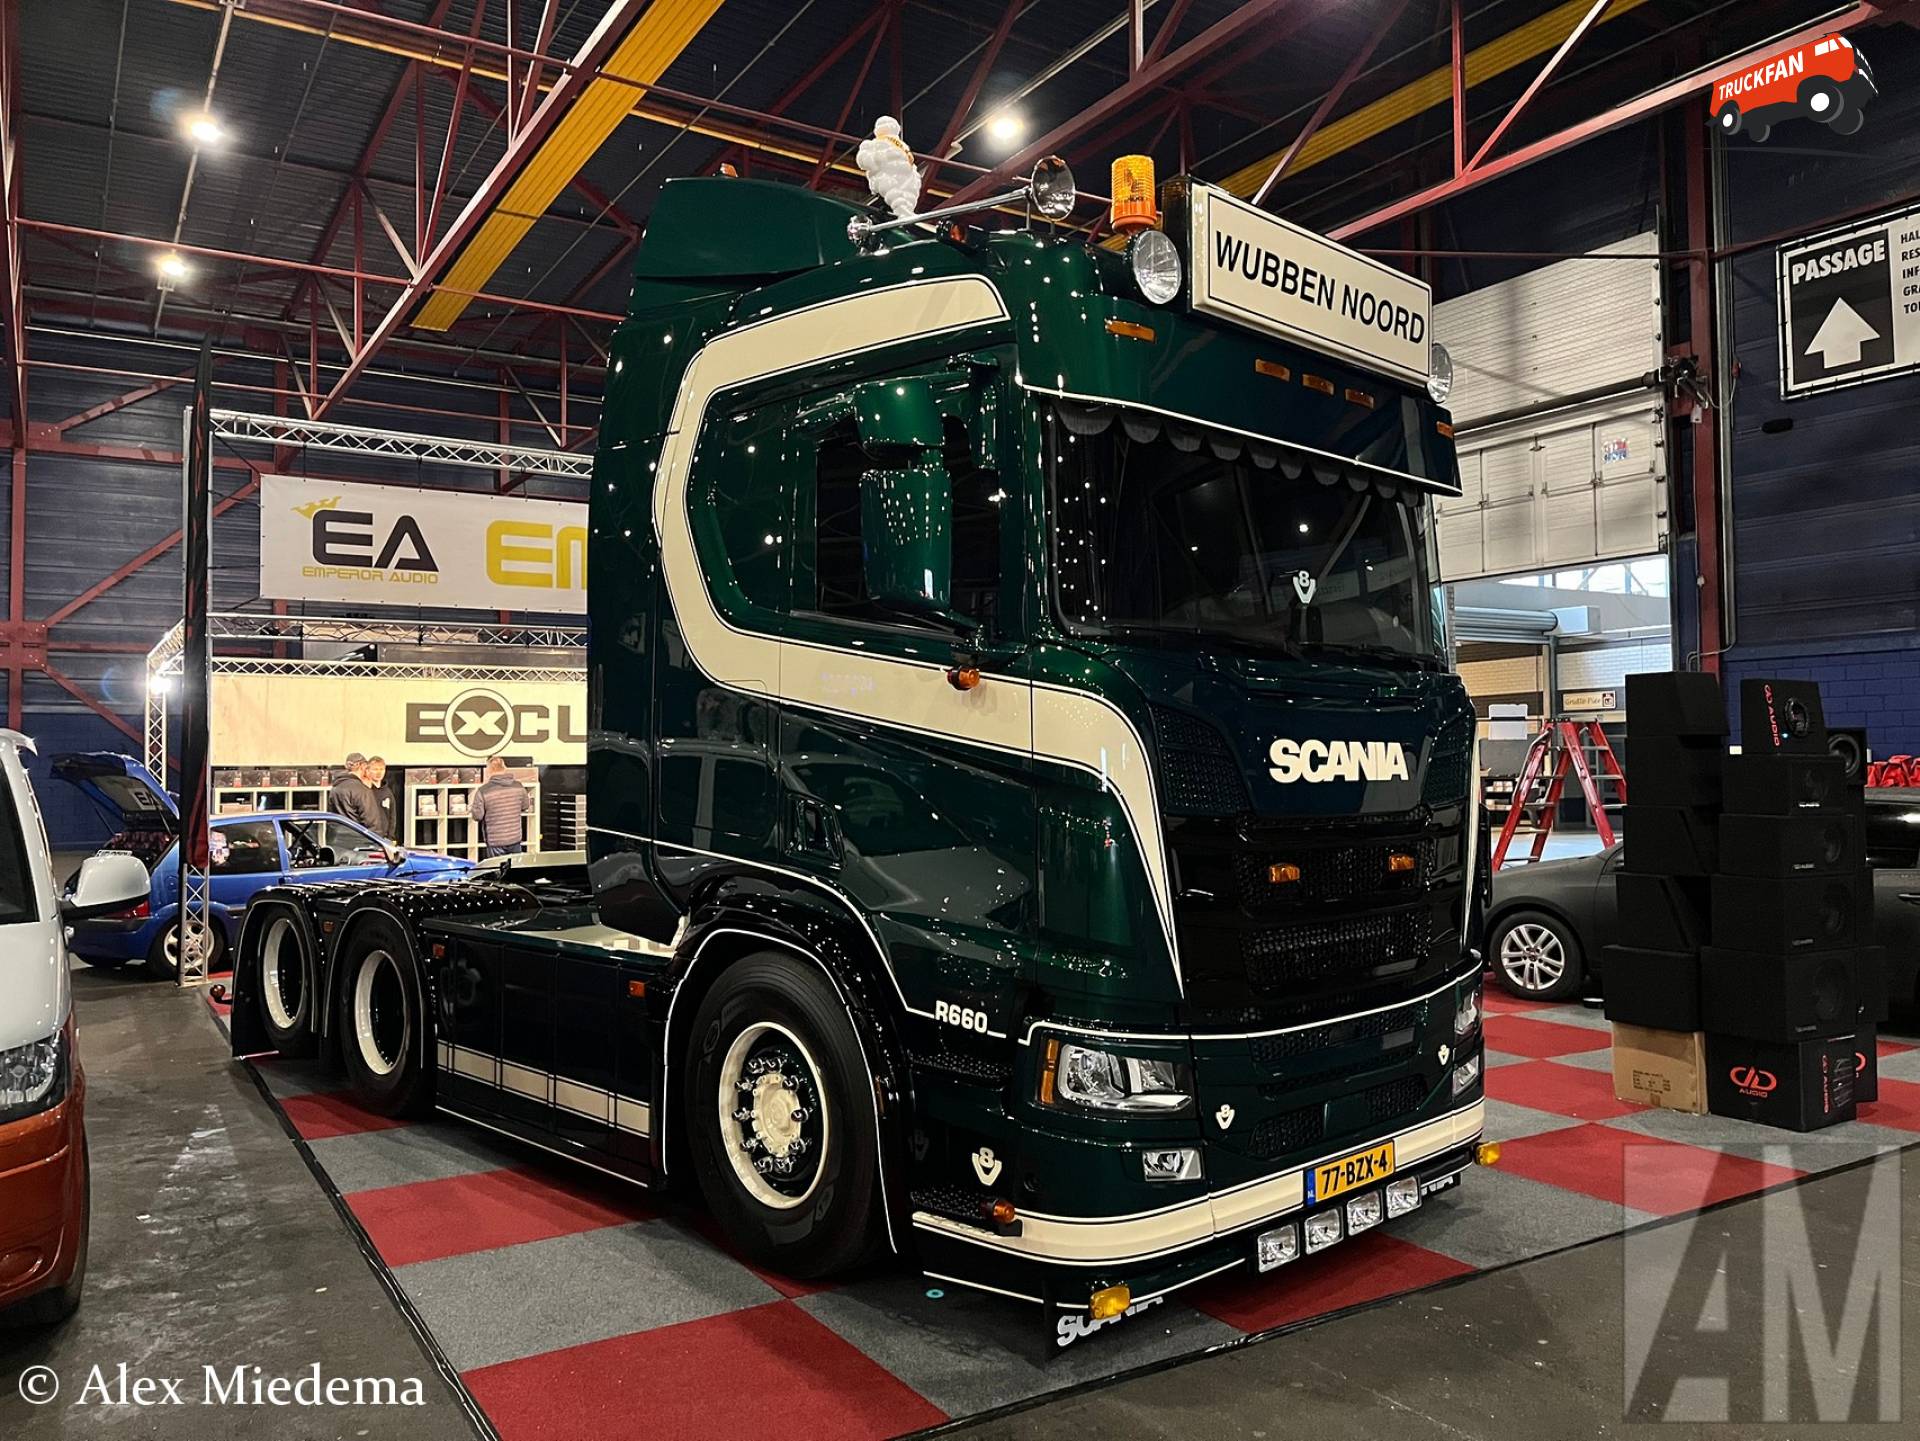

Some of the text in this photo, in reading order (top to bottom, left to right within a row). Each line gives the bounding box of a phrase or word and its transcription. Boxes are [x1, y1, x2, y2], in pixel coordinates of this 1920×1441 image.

[1792, 239, 1886, 284] PASSAGE
[1216, 231, 1425, 344] WUBBEN NOORD
[1903, 285, 1920, 296] GR
[1904, 301, 1920, 314] TO
[312, 509, 439, 572] EA
[302, 566, 439, 585] EMPEROR AUDIO
[1269, 738, 1409, 784] SCANIA
[935, 1000, 988, 1033] R660
[1321, 1149, 1388, 1195] 77-BZX-4
